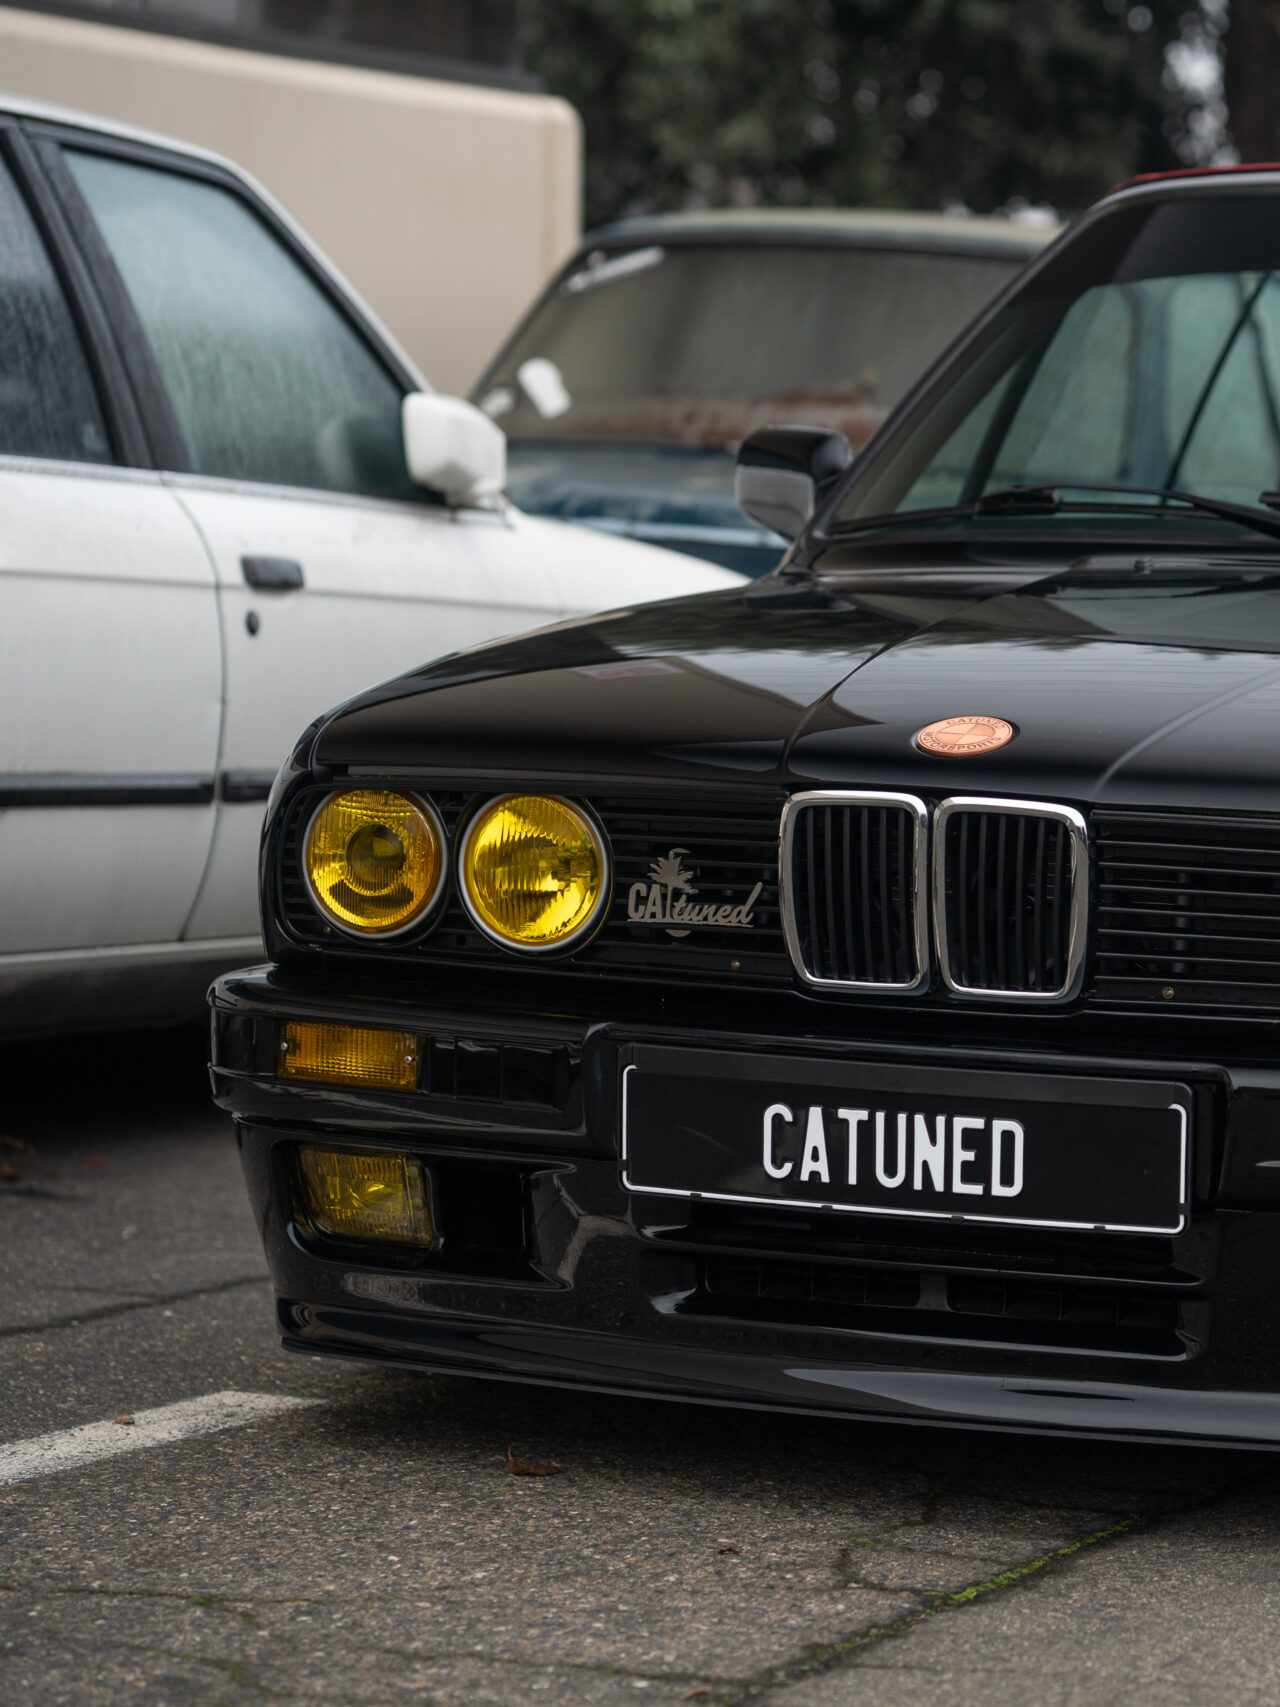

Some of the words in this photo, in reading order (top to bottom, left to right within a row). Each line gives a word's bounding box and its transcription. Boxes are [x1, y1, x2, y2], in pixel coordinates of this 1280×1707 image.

[947, 718, 1006, 729] CATUNED
[923, 732, 1001, 750] MOTORSPORTS
[763, 1103, 1024, 1198] CATUNED
